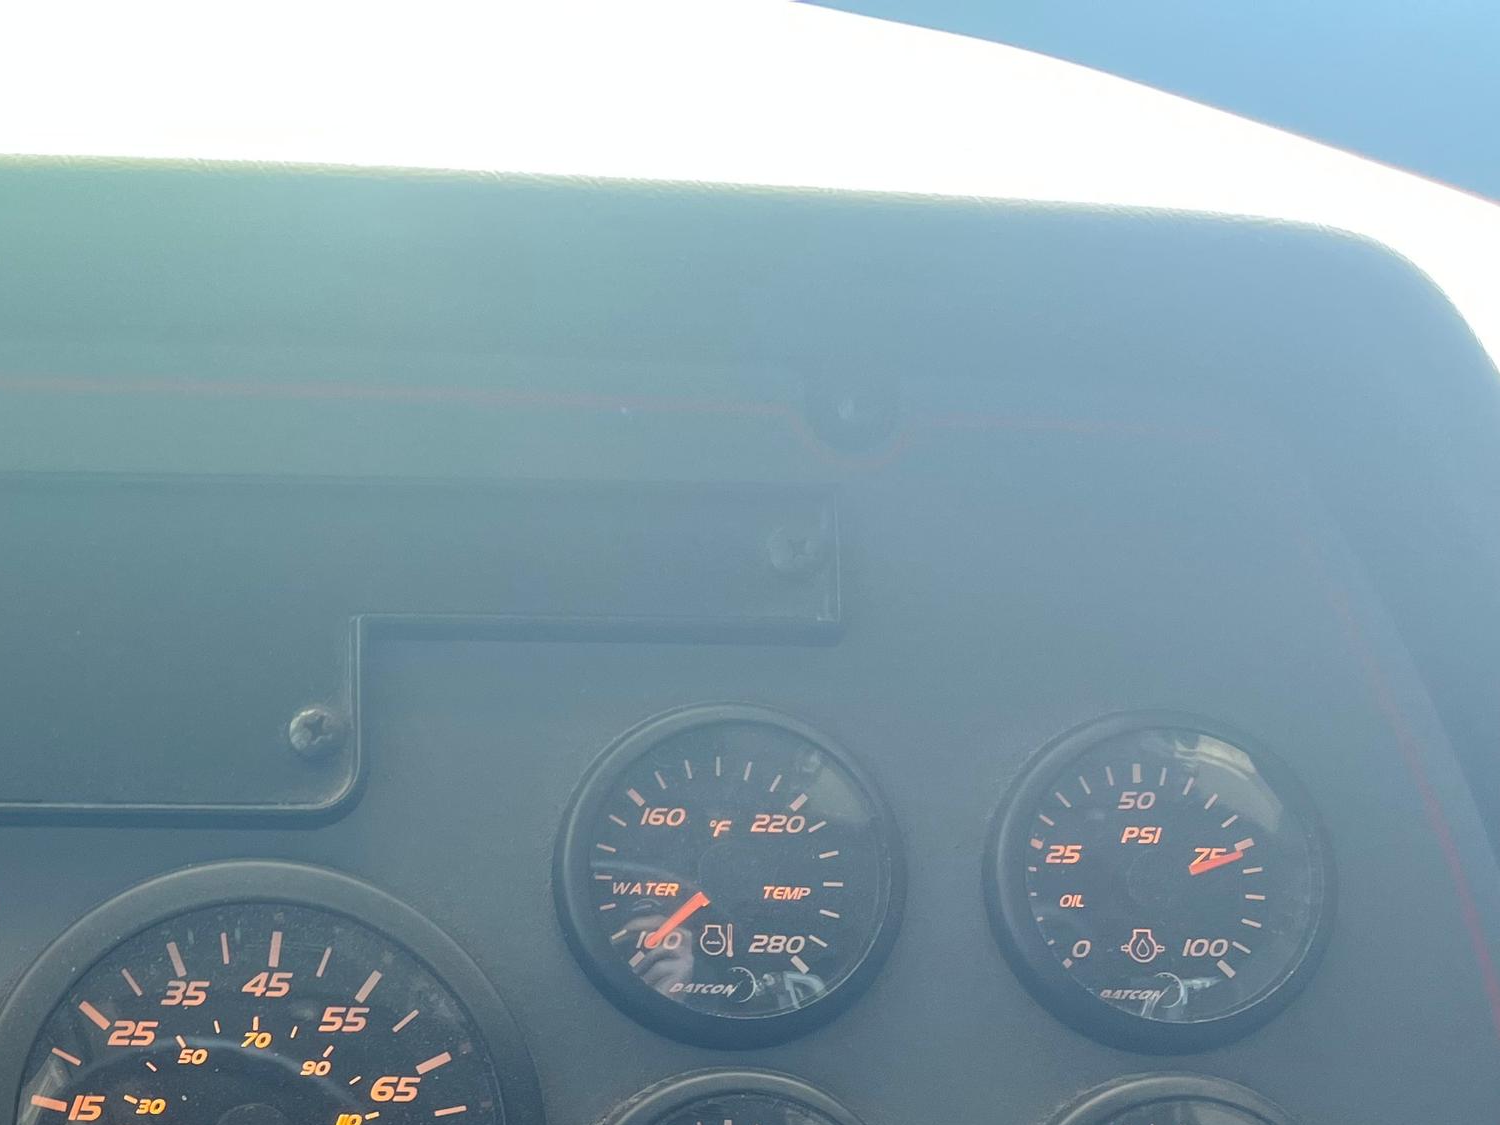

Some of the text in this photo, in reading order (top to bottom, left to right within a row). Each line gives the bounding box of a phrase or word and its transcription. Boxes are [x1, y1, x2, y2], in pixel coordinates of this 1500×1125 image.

[1117, 791, 1156, 810] 50
[640, 807, 686, 827] 160
[750, 814, 806, 834] 220
[1120, 827, 1163, 844] PSI
[1045, 844, 1083, 864] 25
[612, 882, 680, 897] WATER
[763, 885, 811, 901] TEMP
[1059, 894, 1084, 908] OIL
[636, 931, 682, 950] 100
[748, 935, 805, 954] 280
[1071, 939, 1091, 958] 0
[1182, 938, 1229, 957] 100
[160, 980, 210, 1006] 35
[241, 972, 293, 998] 45
[668, 982, 738, 997] DATCON
[1100, 989, 1165, 1000] DATCON
[319, 1006, 370, 1033] 55
[107, 1021, 159, 1046] 25
[241, 1032, 272, 1049] 70
[177, 1049, 208, 1066] 50
[300, 1060, 332, 1077] 90
[369, 1076, 421, 1102] 65
[67, 1095, 106, 1121] 15
[136, 1099, 166, 1115] 30
